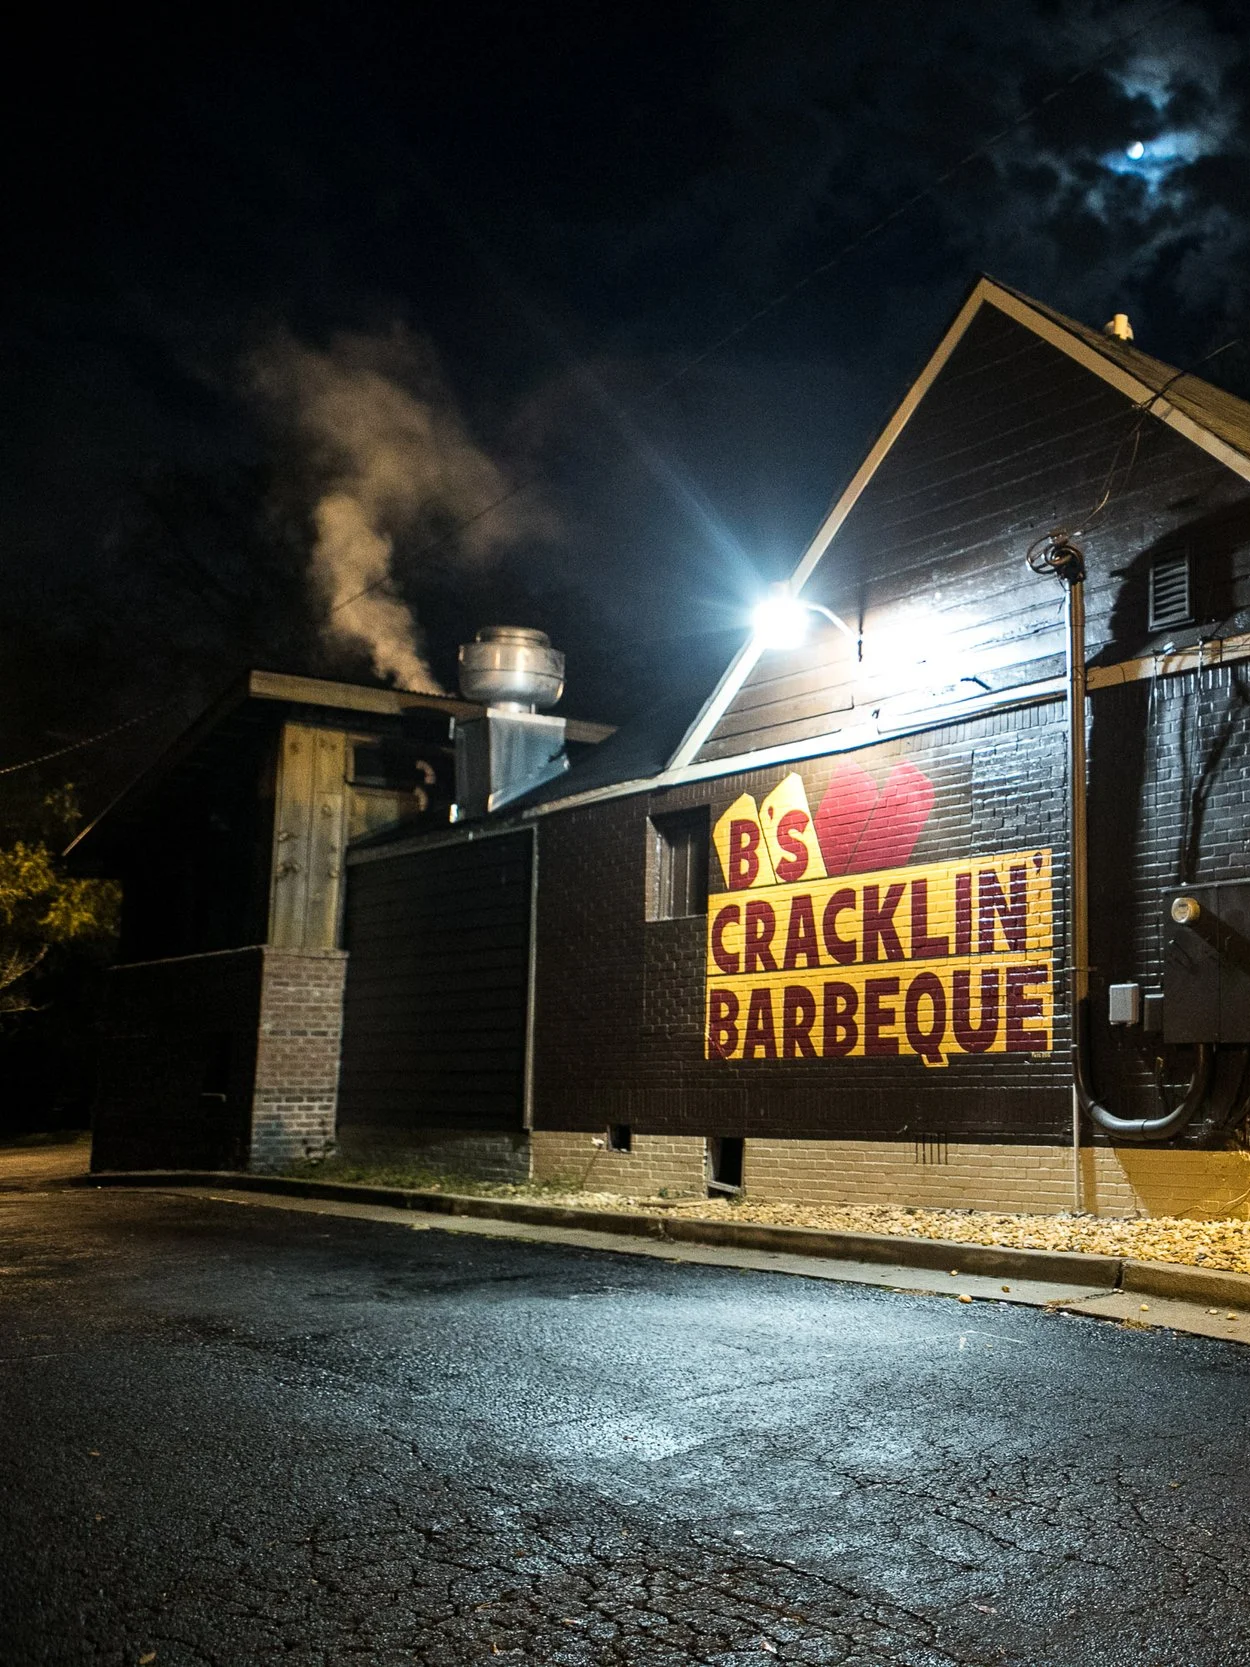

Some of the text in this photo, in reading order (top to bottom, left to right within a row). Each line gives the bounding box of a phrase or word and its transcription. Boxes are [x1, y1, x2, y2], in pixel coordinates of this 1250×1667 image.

[730, 806, 811, 889] B'S
[711, 851, 1043, 974] CRACKLIN'
[708, 964, 1048, 1063] BARBEQUE
